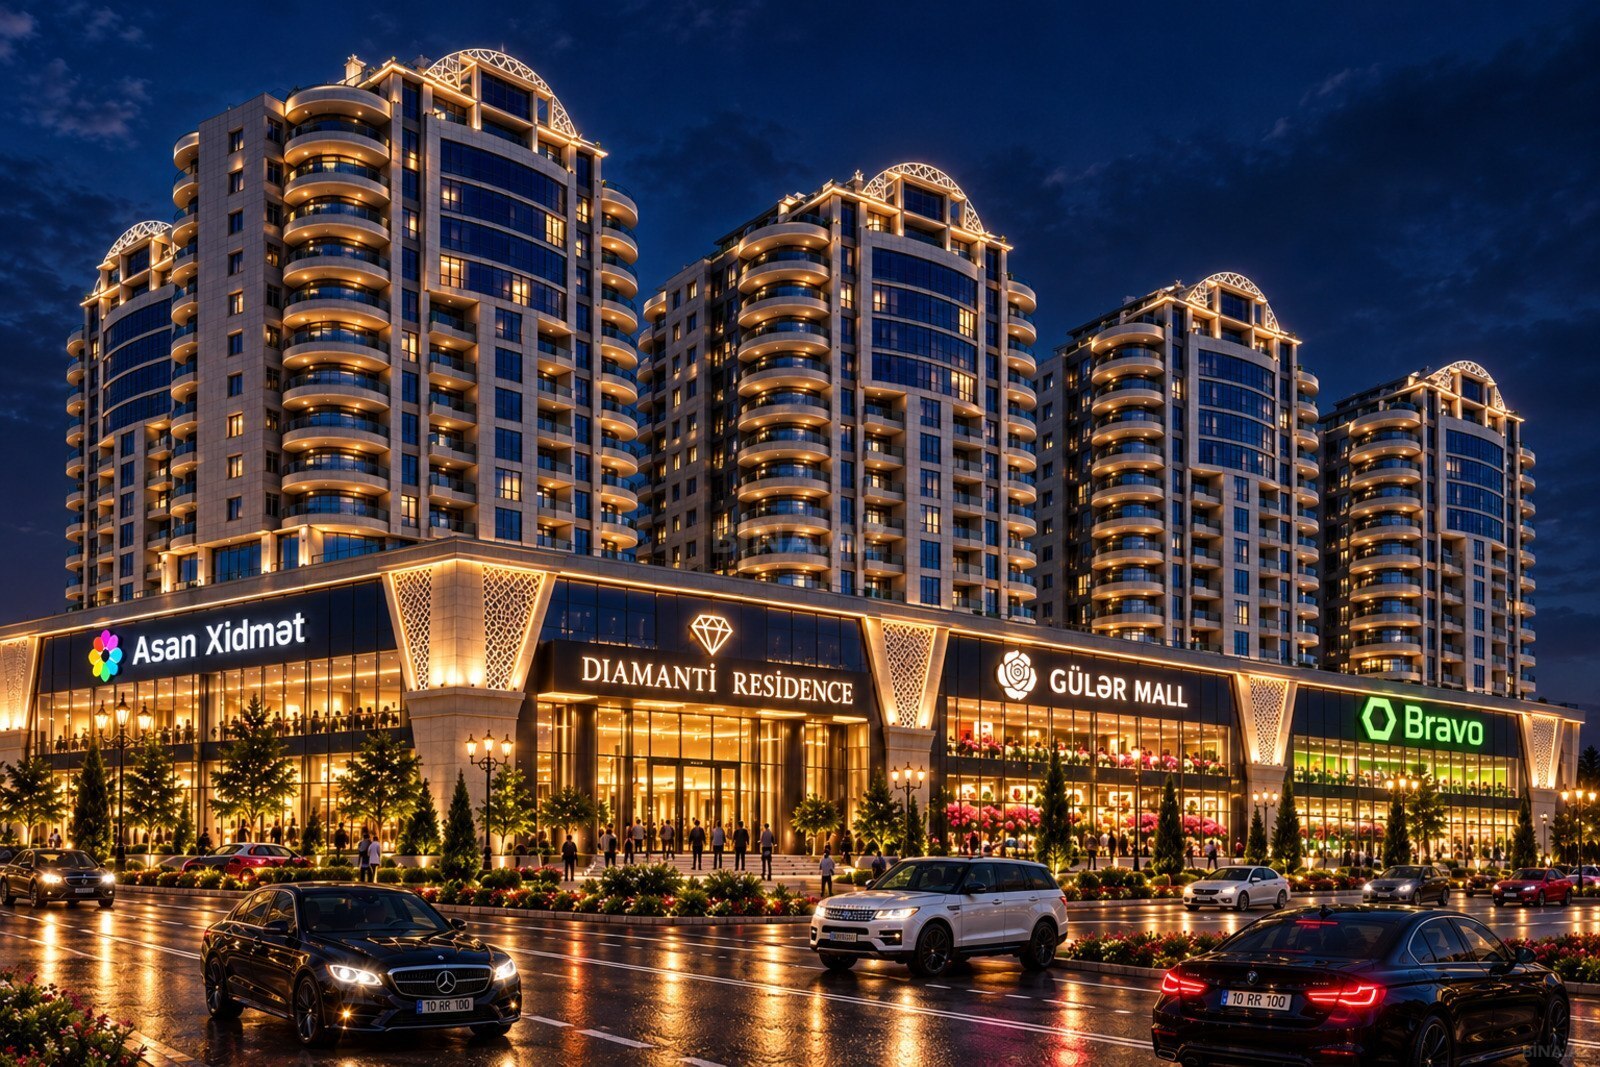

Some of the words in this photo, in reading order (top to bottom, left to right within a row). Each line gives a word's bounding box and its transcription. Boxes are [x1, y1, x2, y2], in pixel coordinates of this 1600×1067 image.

[132, 632, 197, 665] Asan
[205, 612, 306, 656] Xidmət
[581, 656, 717, 693] DIAMANTİ
[732, 670, 854, 705] RESİDENCE
[1134, 679, 1189, 708] MALL
[1405, 704, 1484, 746] Bravo
[426, 1001, 437, 1012] 10
[439, 1000, 451, 1011] RR
[455, 999, 470, 1010] 100
[1233, 992, 1244, 1005] 10
[1246, 993, 1262, 1006] RR
[1266, 995, 1286, 1008] 100
